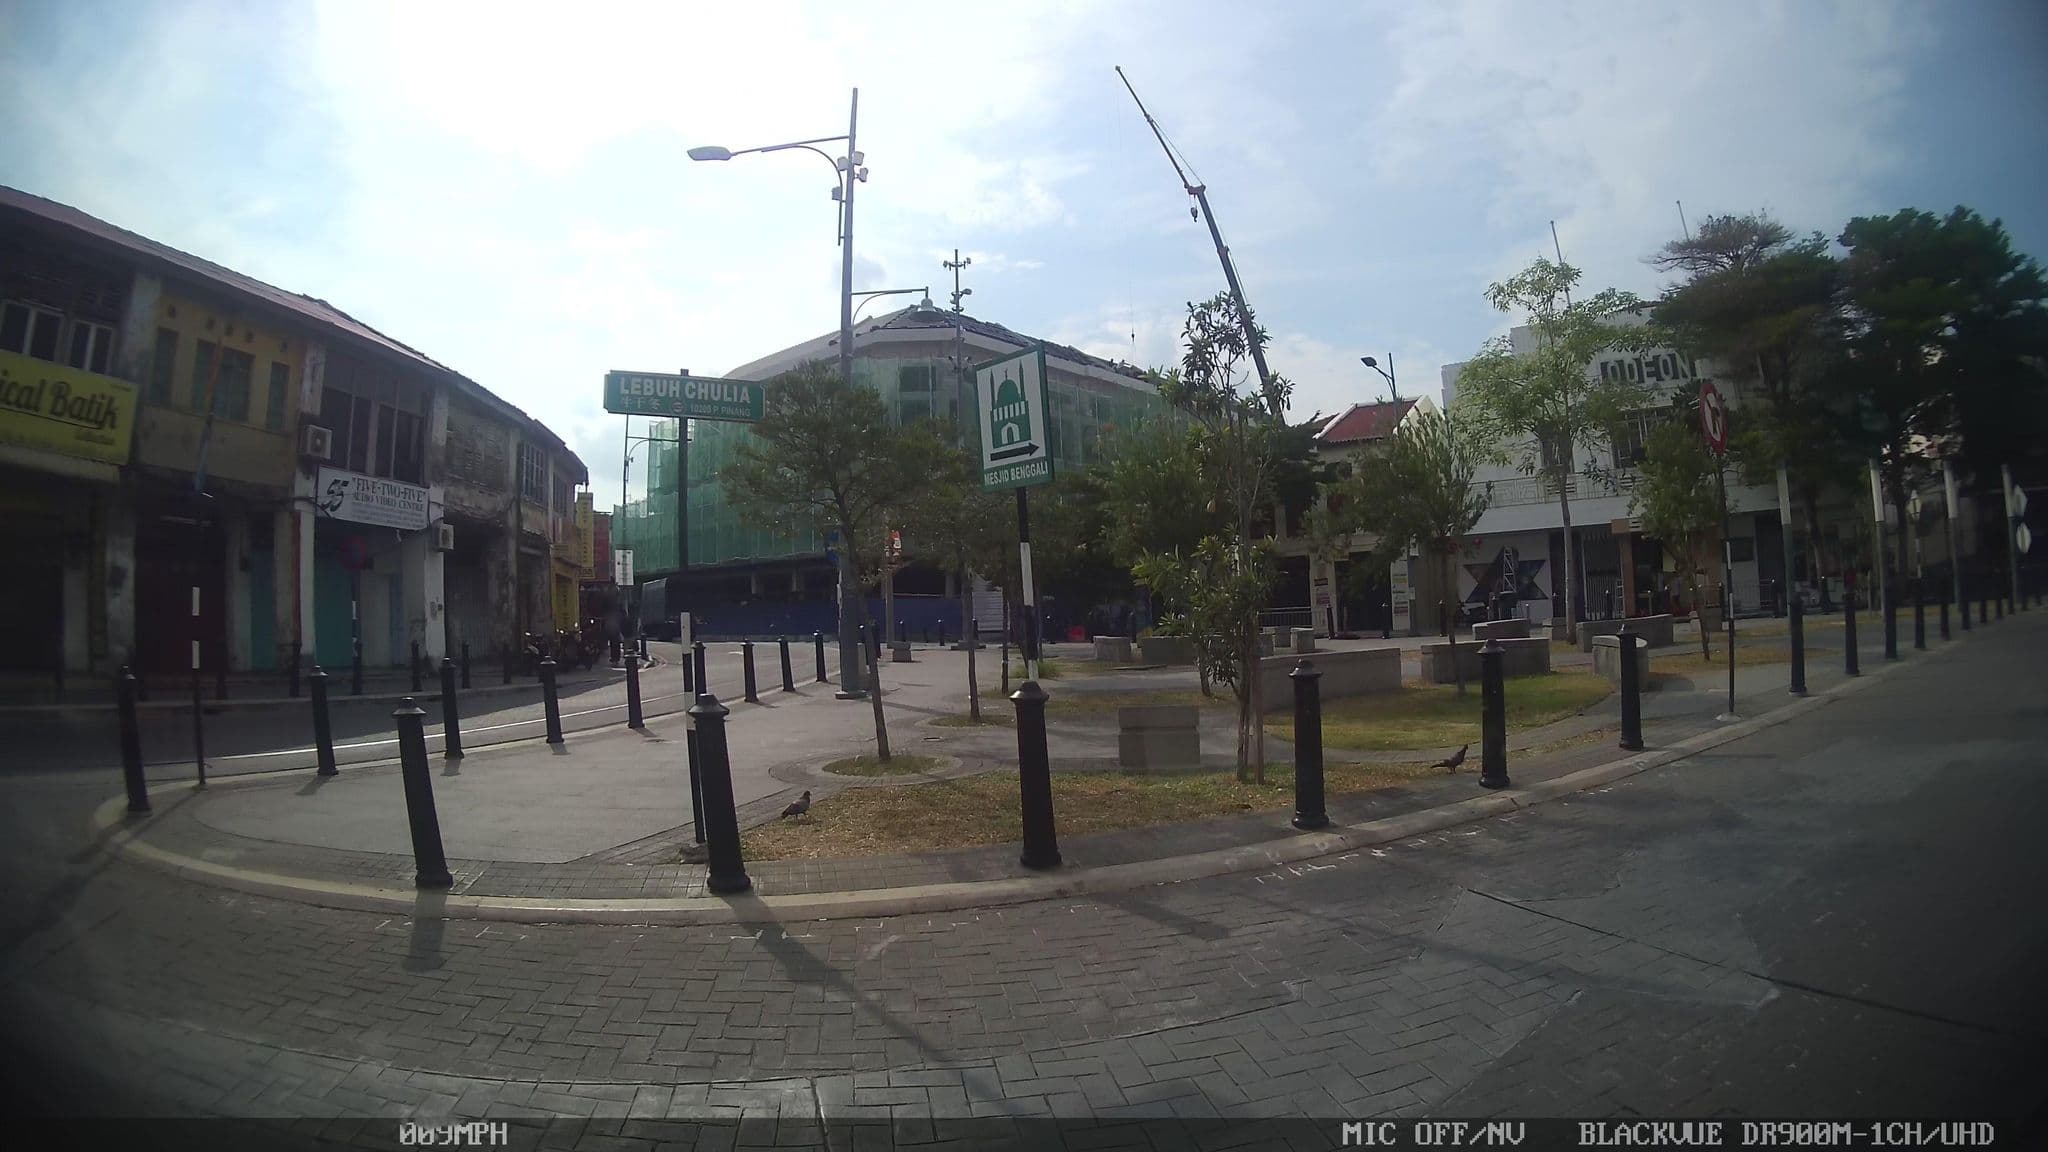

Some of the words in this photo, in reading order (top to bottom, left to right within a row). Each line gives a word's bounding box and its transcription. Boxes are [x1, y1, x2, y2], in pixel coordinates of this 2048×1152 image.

[619, 376, 680, 398] LEBUH
[684, 383, 750, 403] CHULIA
[50, 381, 119, 430] Batik
[984, 470, 1008, 486] MESJID
[1011, 461, 1048, 480] BENGGALI
